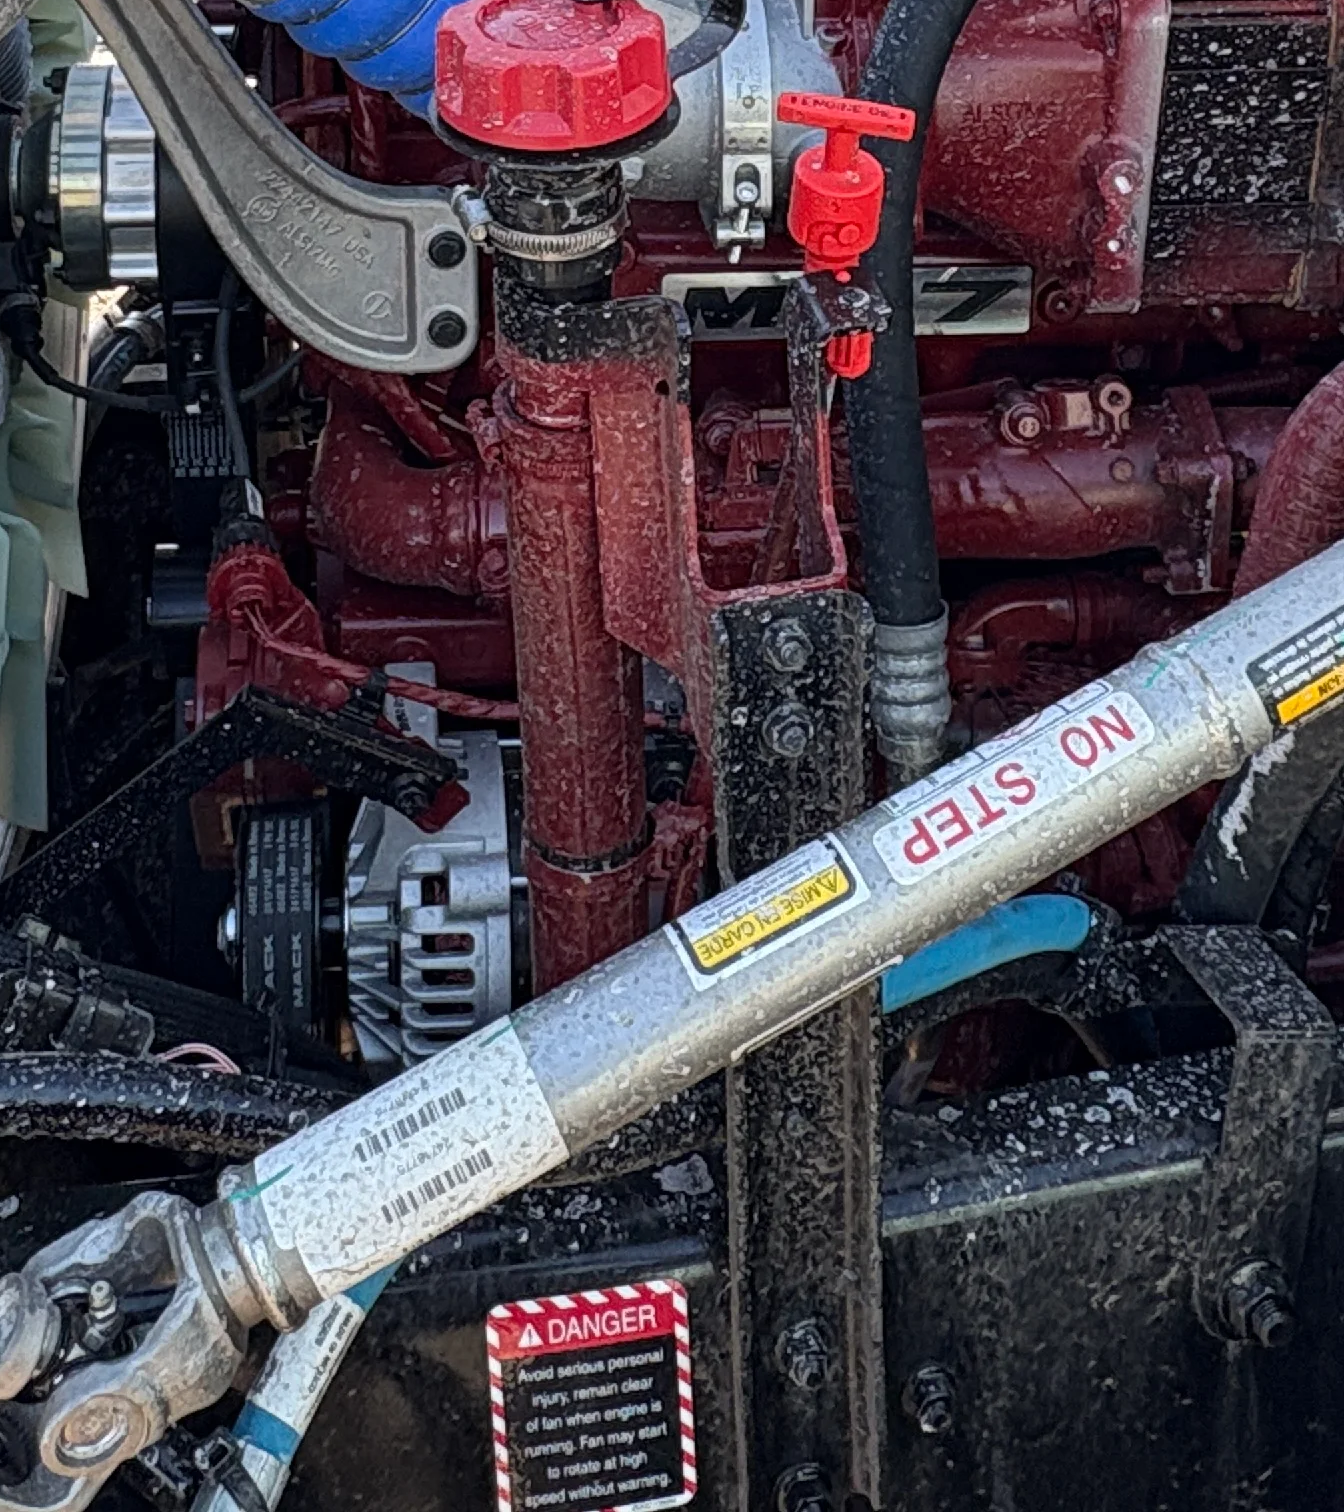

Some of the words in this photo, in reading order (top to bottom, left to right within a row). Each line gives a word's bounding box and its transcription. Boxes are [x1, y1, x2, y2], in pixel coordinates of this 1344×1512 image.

[344, 238, 376, 270] USA
[1061, 703, 1136, 771] NO
[902, 761, 1039, 866] STEP
[291, 931, 304, 1008] MACK
[548, 1304, 657, 1344] DANGER
[518, 1367, 554, 1384] Avoid
[557, 1360, 605, 1378] serious
[608, 1348, 664, 1370] personal
[573, 1384, 618, 1401] remain
[622, 1376, 654, 1393] clear
[526, 1418, 539, 1433] of
[542, 1415, 563, 1430] fan
[566, 1408, 601, 1426] when
[605, 1402, 648, 1423] engine
[651, 1399, 662, 1412] is
[524, 1440, 576, 1459] running.
[580, 1434, 604, 1449] Fan
[607, 1430, 634, 1446] may
[638, 1422, 668, 1439] start
[547, 1466, 559, 1480] to
[563, 1459, 601, 1478] rotate
[604, 1457, 617, 1471] at
[620, 1450, 648, 1470] high
[525, 1488, 566, 1508] speed
[568, 1479, 615, 1500] without
[618, 1471, 673, 1492] warning.
